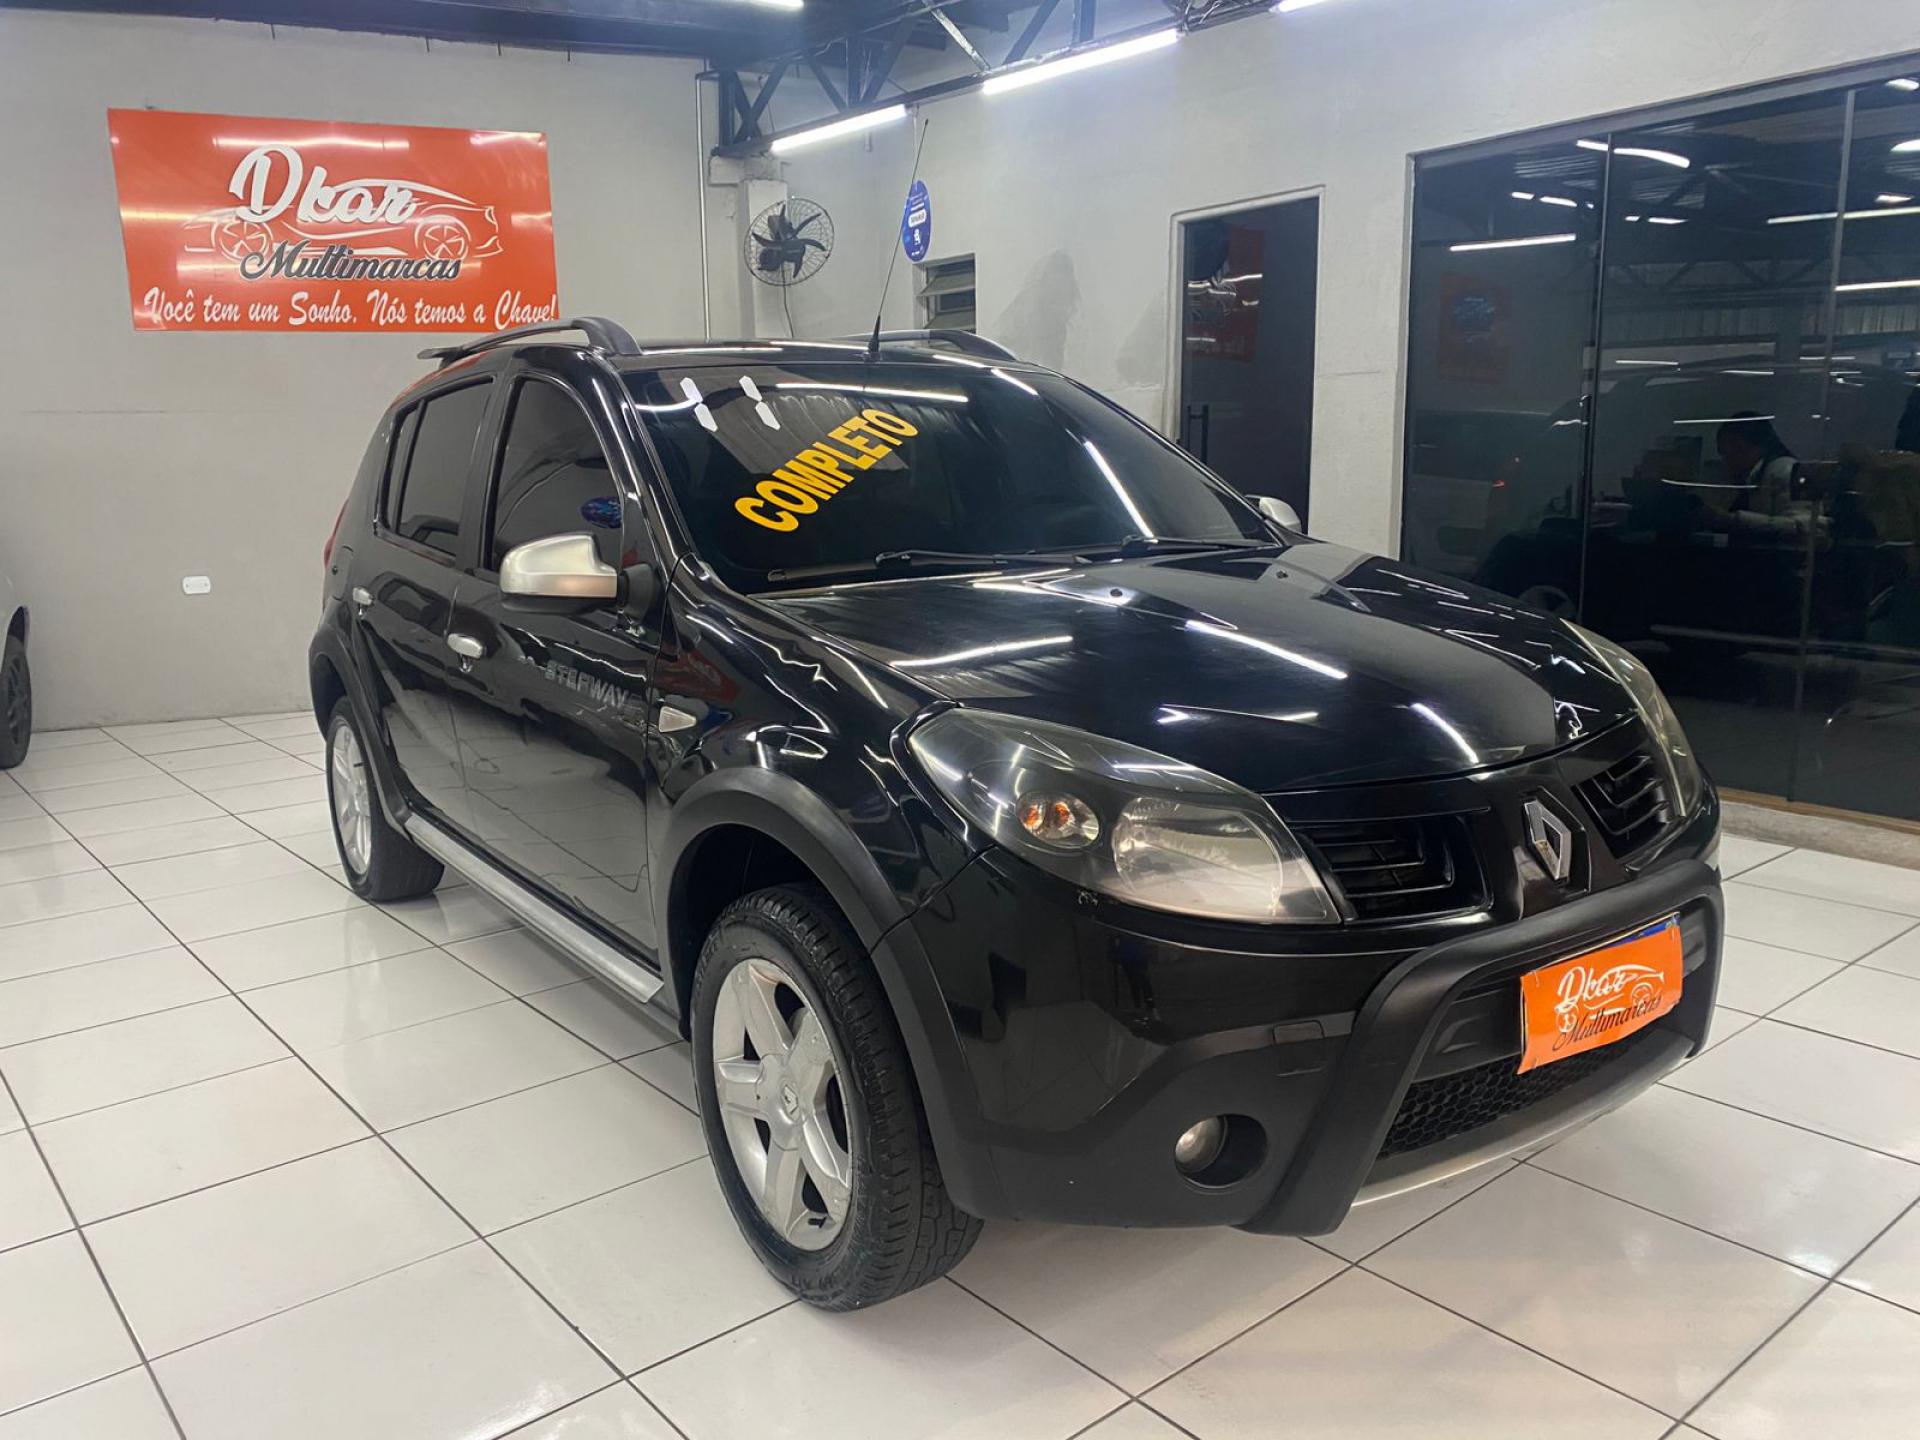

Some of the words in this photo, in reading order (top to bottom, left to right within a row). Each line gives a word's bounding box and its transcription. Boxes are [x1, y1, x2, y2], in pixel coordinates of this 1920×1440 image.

[239, 240, 462, 282] Multimarcas
[143, 286, 195, 325] Você
[203, 294, 241, 324] tem
[248, 301, 281, 324] um
[288, 289, 357, 326] Sonho.
[366, 288, 408, 326] Nós
[414, 297, 465, 325] temos
[473, 303, 487, 325] a
[494, 289, 557, 330] Chave!
[734, 409, 919, 532] COMPLETO
[544, 659, 629, 709] STEPWAY
[1553, 995, 1662, 1051] Multimarcas
